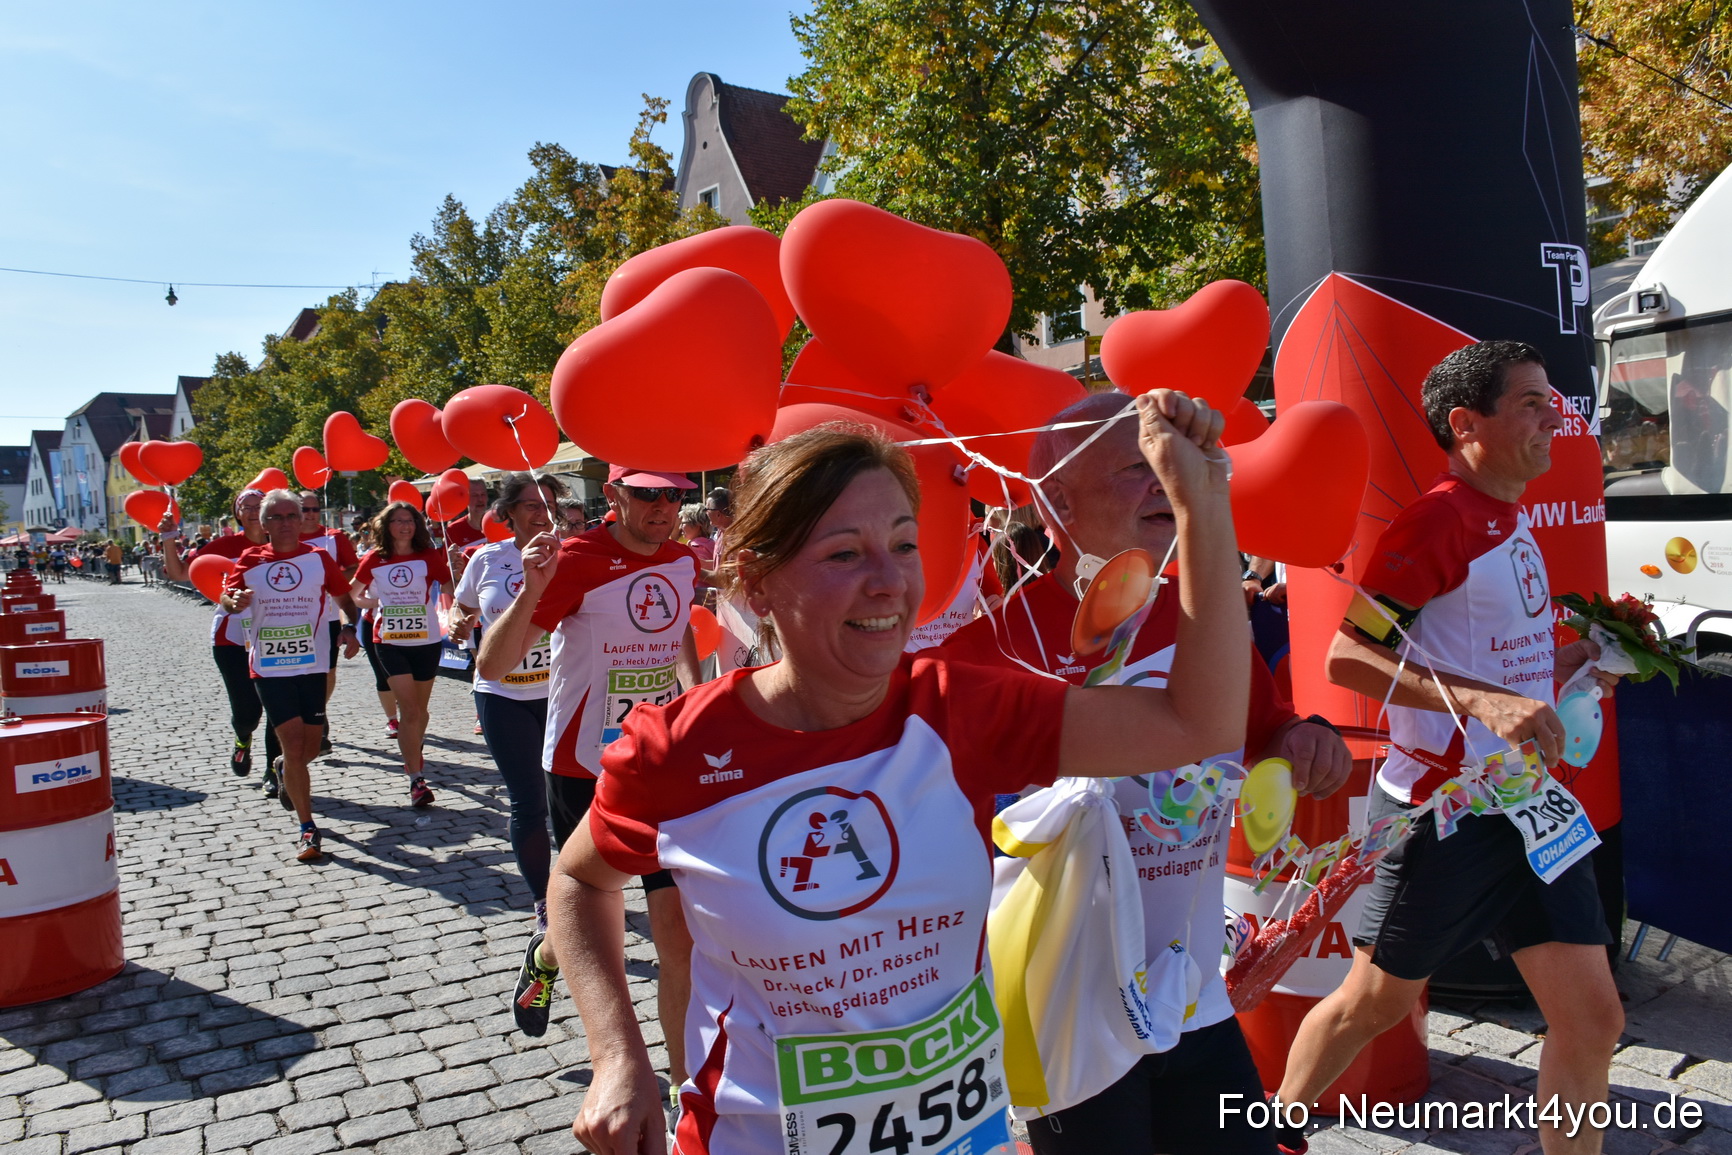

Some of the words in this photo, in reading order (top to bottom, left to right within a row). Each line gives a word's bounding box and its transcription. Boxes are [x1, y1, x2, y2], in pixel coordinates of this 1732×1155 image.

[1546, 251, 1565, 260] Team
[1562, 396, 1591, 415] NEXT
[1522, 501, 1567, 529] MW
[386, 606, 424, 616] BOCK
[262, 625, 309, 639] BOCK
[387, 618, 423, 631] 5125
[265, 640, 309, 655] 2455
[603, 642, 645, 654] LAUFEN
[648, 642, 668, 652] MIT
[1490, 636, 1532, 652] LAUFEN
[275, 657, 302, 665] JOSEF
[626, 657, 645, 665] Heck
[1502, 658, 1517, 668] Dr.
[1055, 664, 1086, 676] erima
[616, 667, 676, 690] BOCK
[67, 774, 93, 785] energie
[699, 768, 744, 785] erima
[1537, 823, 1587, 869] JOHANNES
[731, 948, 826, 972] LAUFEN
[840, 931, 884, 959] MIT
[897, 911, 965, 940] HERZ
[763, 979, 788, 992] Dr.
[789, 977, 834, 995] Heck
[852, 967, 878, 984] Dr.
[882, 943, 940, 972] Röschl
[797, 990, 990, 1093] BOCK
[816, 1057, 987, 1155] 2458
